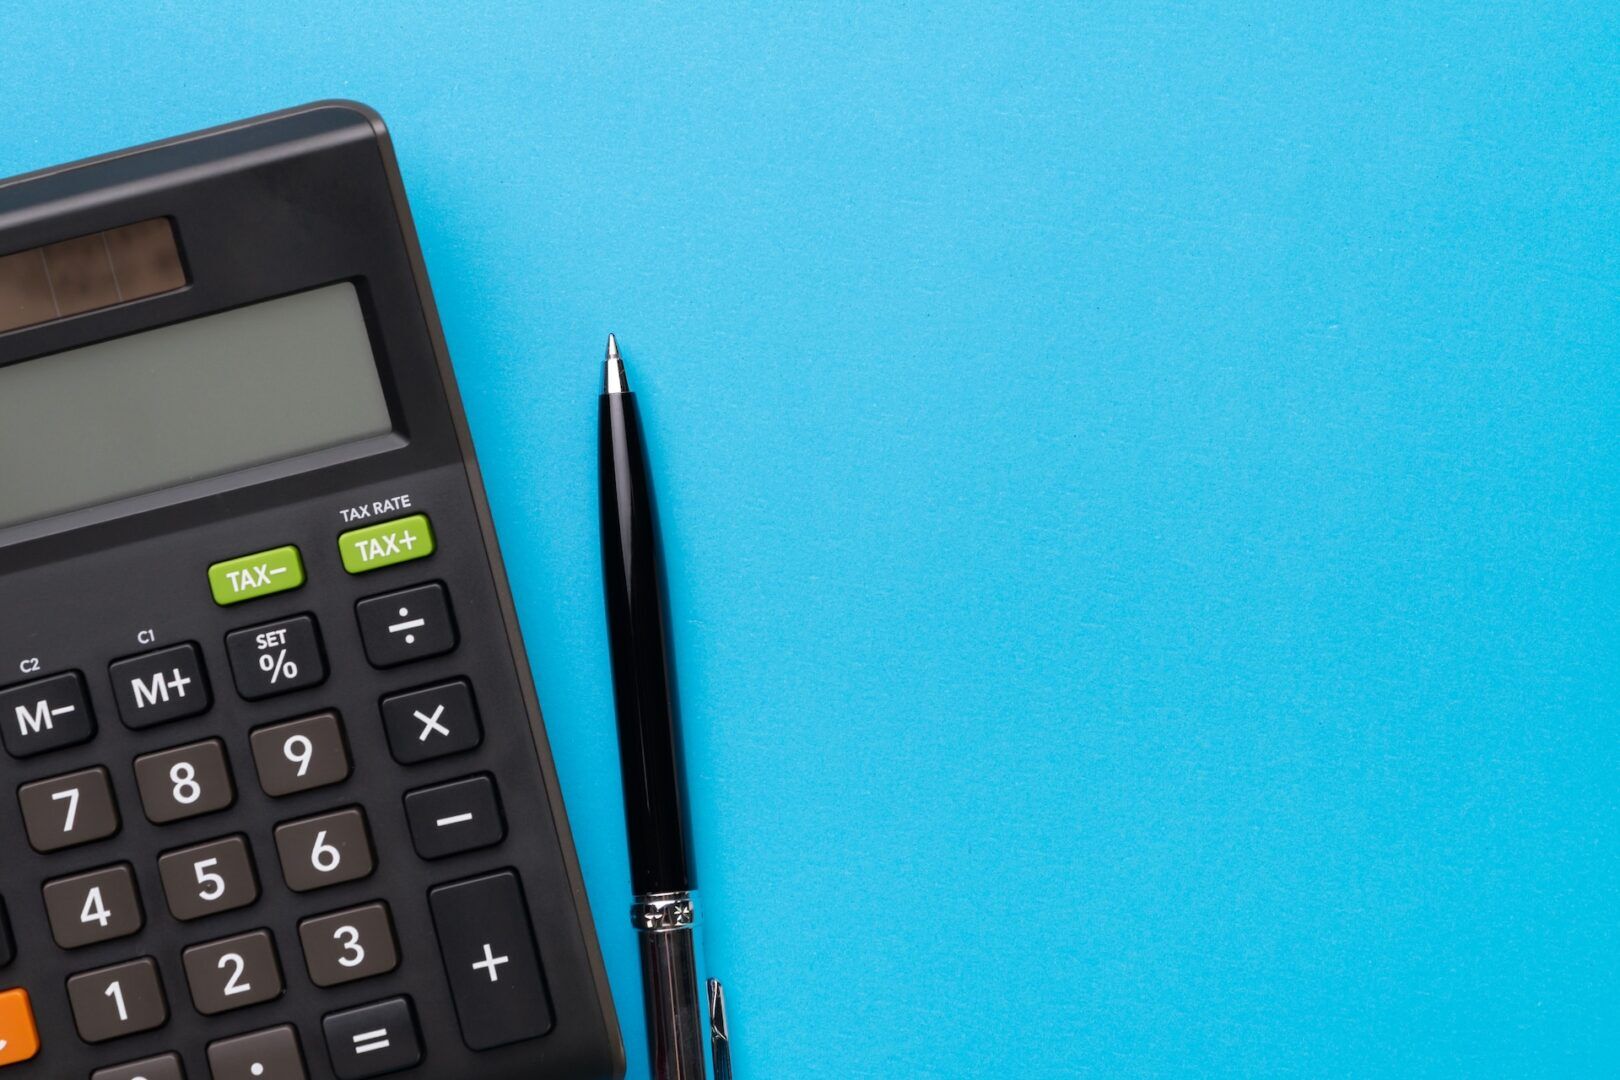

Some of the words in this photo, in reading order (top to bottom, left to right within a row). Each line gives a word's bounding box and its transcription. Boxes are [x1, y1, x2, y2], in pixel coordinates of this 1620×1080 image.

[339, 504, 371, 523] TAX
[372, 494, 412, 515] RATE
[354, 530, 417, 562] TAX+
[225, 563, 287, 593] TAX-
[137, 629, 155, 644] C1
[255, 628, 287, 650] SET
[19, 657, 41, 674] C2
[258, 648, 298, 684] %
[131, 668, 191, 709] M+
[14, 699, 75, 736] M-
[283, 734, 313, 777] 9
[169, 761, 201, 804] 8
[51, 787, 80, 832] 7
[310, 830, 341, 872] 6
[193, 857, 226, 901] 5
[80, 886, 112, 927] 4
[333, 925, 365, 967] 3
[217, 952, 251, 996] 2
[104, 981, 128, 1021] 1
